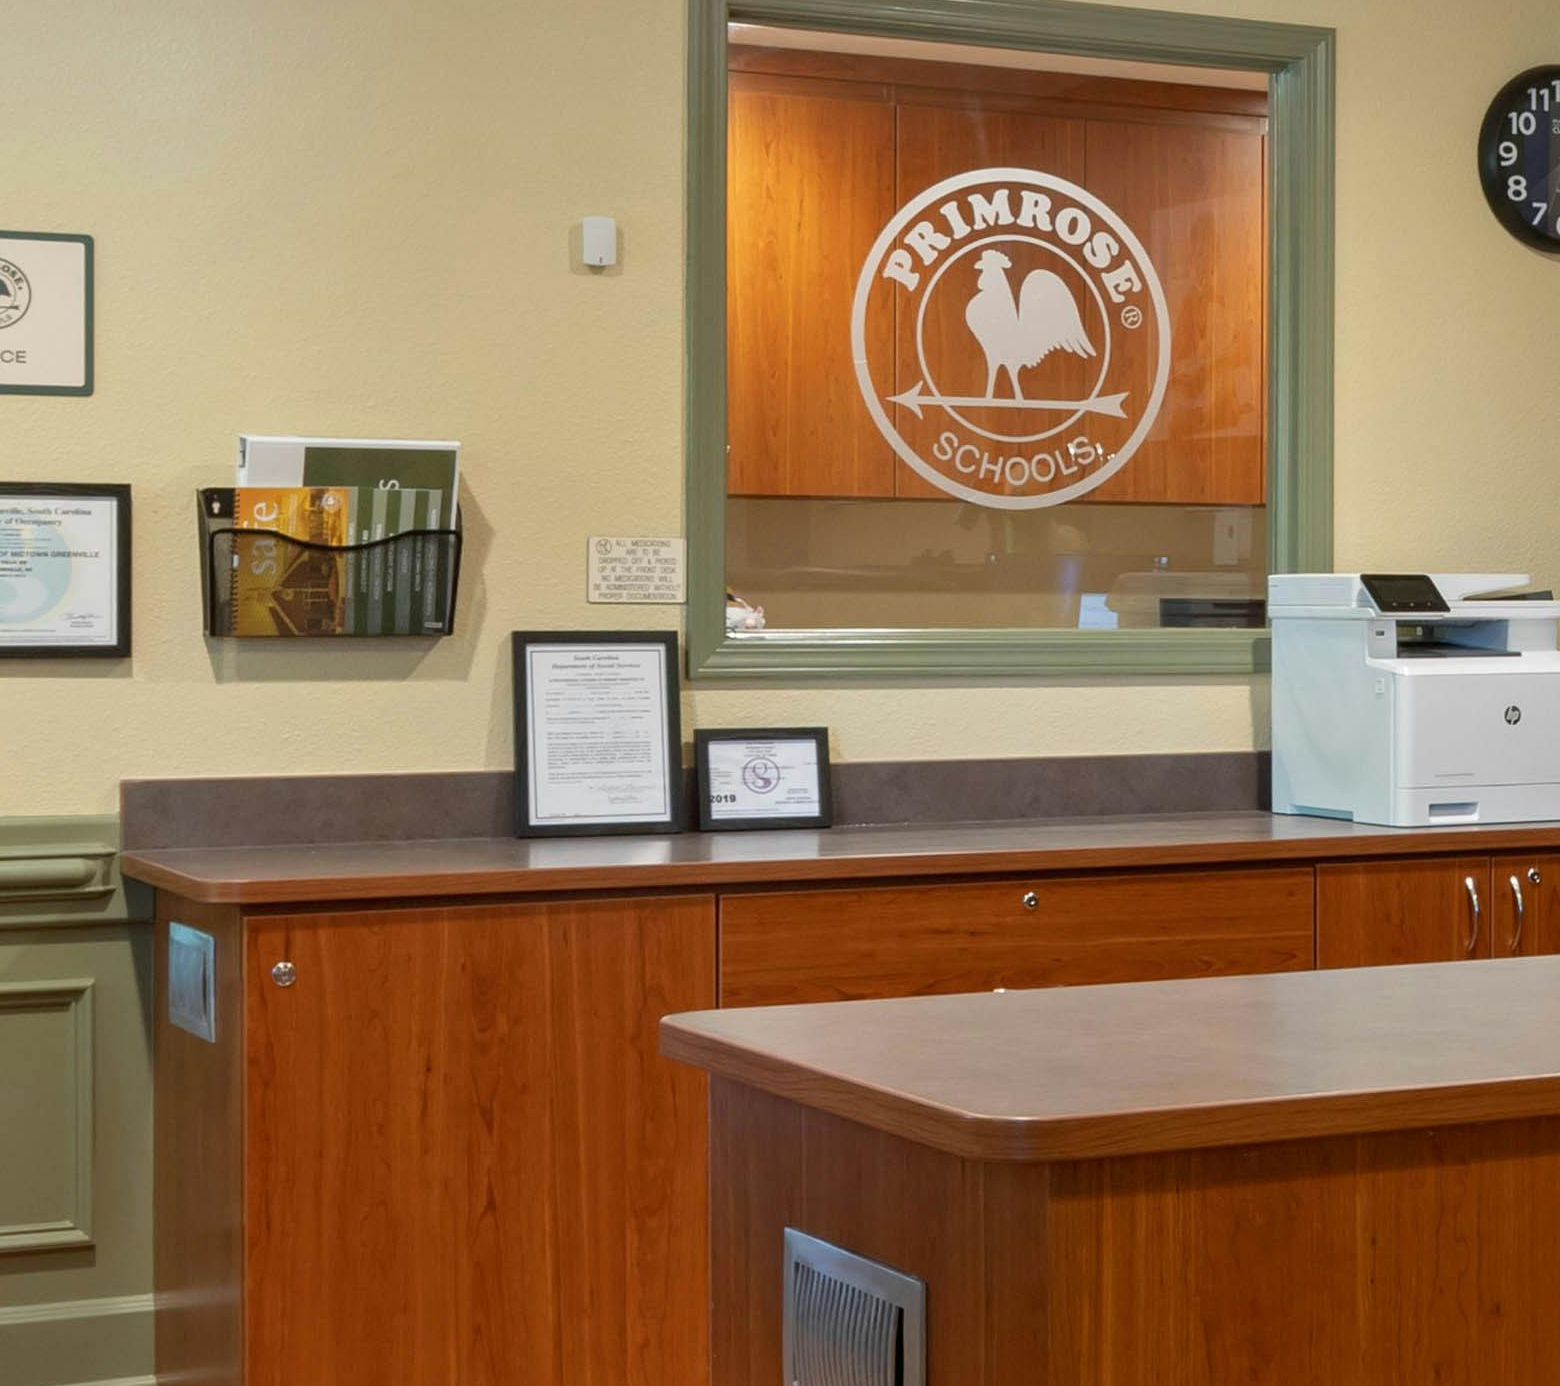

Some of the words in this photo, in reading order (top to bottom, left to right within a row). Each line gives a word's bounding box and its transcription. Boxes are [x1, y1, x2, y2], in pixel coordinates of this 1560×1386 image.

[1527, 88, 1550, 112] 11
[1508, 112, 1537, 136] 10
[1498, 141, 1518, 167] 9
[1507, 175, 1528, 202] 8
[1532, 202, 1548, 226] 7
[883, 188, 1142, 304] PRIMROSE
[932, 431, 1096, 486] SCHOOLS
[710, 794, 737, 804] 2019
